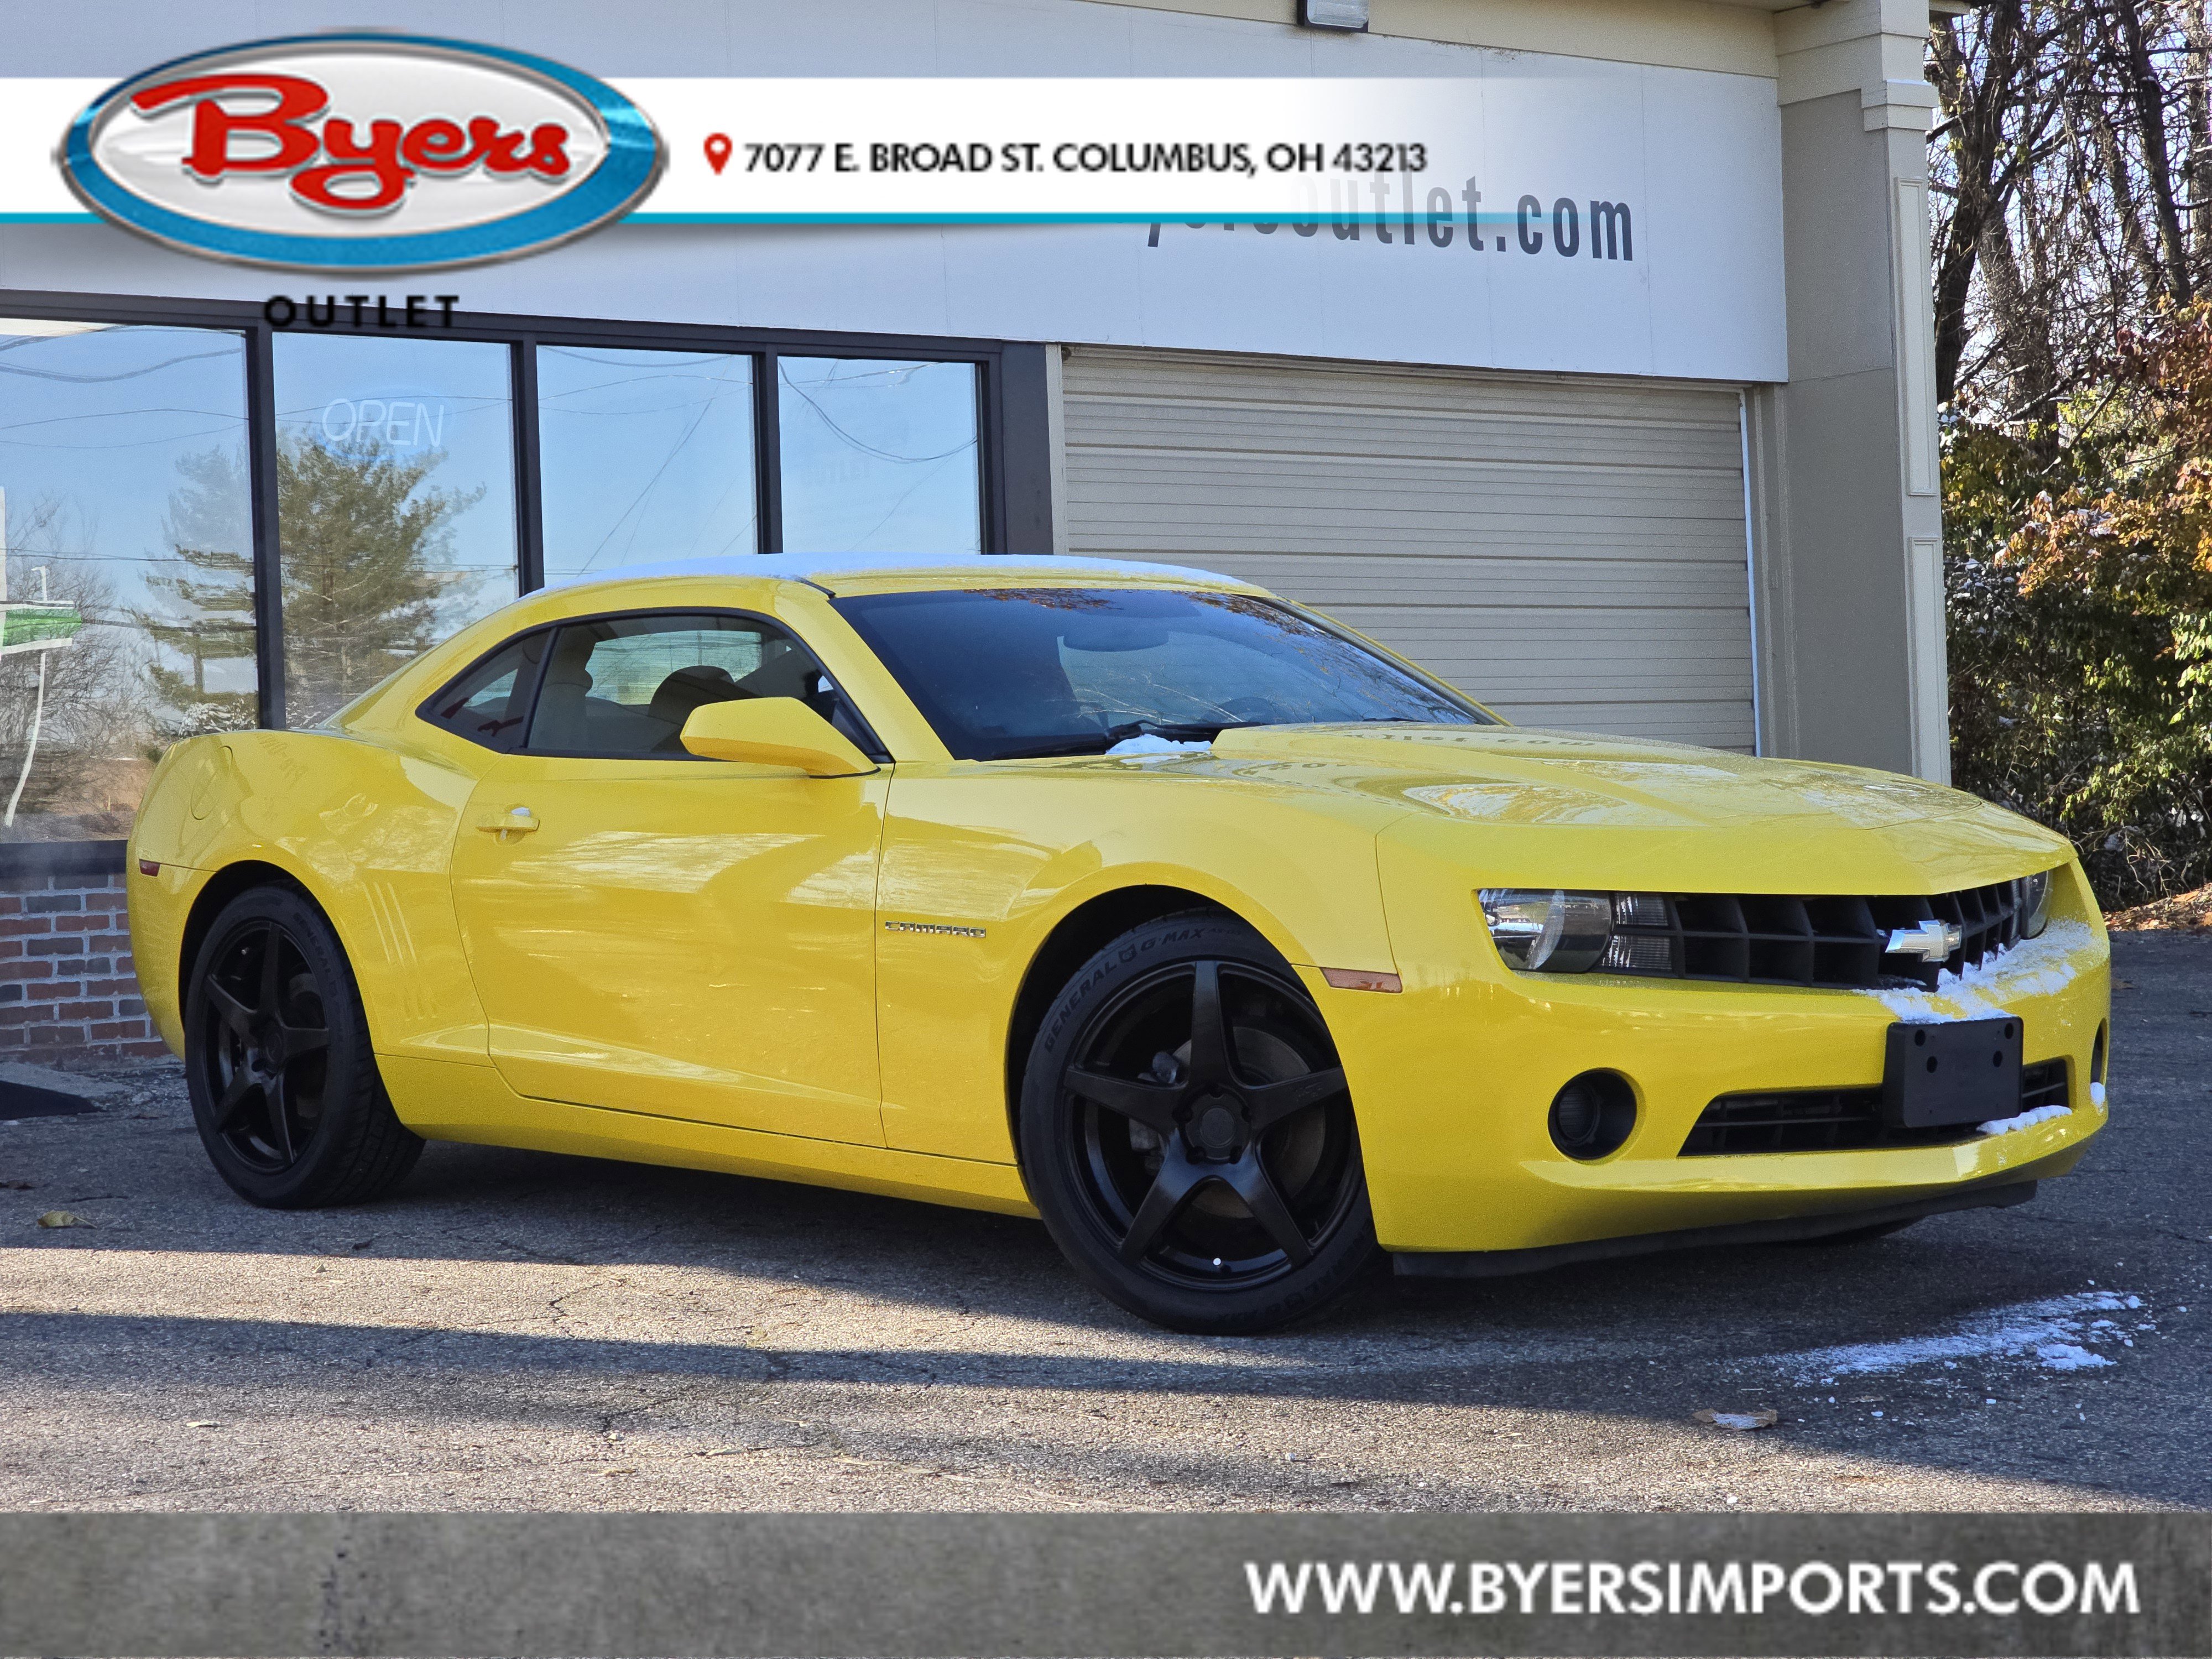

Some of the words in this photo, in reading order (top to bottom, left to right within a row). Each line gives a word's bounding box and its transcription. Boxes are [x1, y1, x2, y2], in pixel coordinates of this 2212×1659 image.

[322, 398, 444, 447] OPEN
[885, 921, 987, 938] CAMARO
[1044, 962, 1117, 1054] GENERAL
